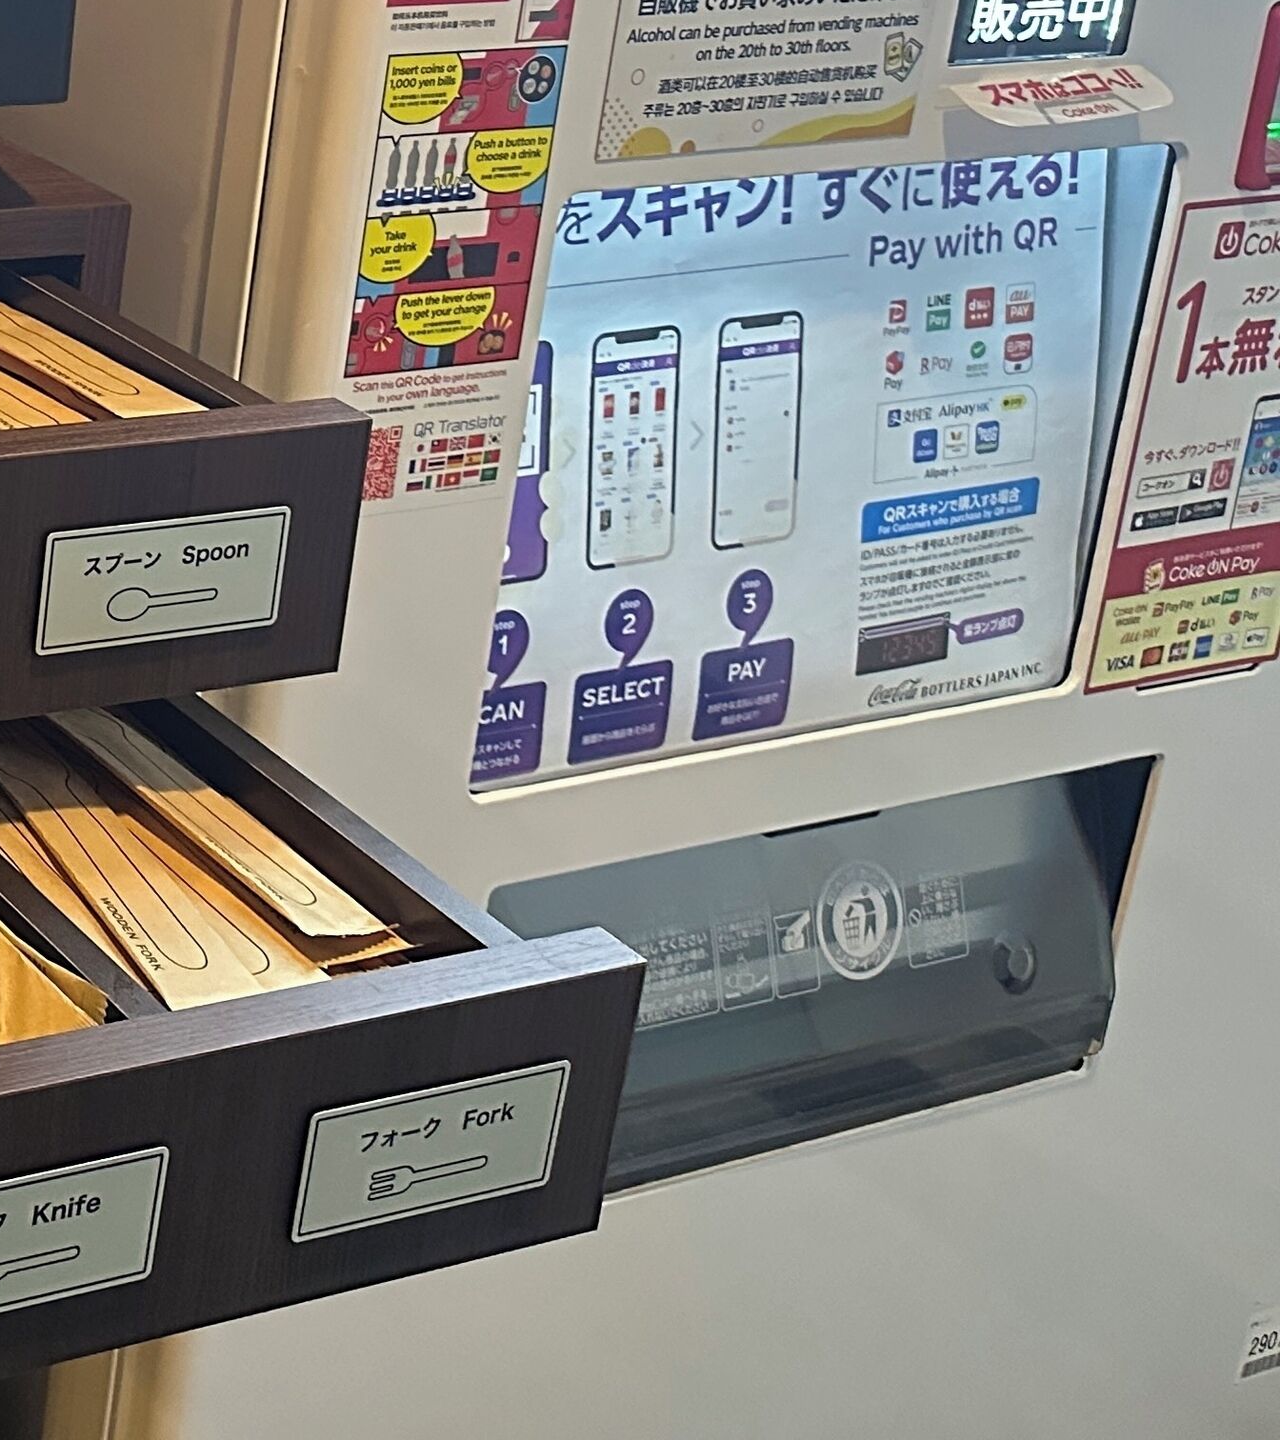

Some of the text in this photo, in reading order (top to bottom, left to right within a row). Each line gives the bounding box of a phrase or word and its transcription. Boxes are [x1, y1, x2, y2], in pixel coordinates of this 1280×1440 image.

[627, 13, 919, 44] Alcohol can be purchased from vending machines
[696, 37, 851, 62] on the 20th to 30th floors.
[392, 64, 457, 76] Insert coins or
[390, 75, 456, 89] 1,000 yen bills
[385, 231, 406, 241] Take
[869, 217, 1058, 270] Pay with QR
[370, 241, 417, 256] your drink
[401, 292, 491, 308] Push the lever down
[927, 294, 951, 307] LINE
[1010, 304, 1029, 318] PAY
[402, 304, 486, 321] to get your change
[928, 314, 949, 328] Pay
[414, 415, 507, 437] QR Translator
[83, 539, 250, 577] スプーン Spoon
[1169, 564, 1205, 582] Coke
[1231, 555, 1260, 575] Pay
[743, 592, 756, 614] 3
[1202, 594, 1220, 607] LINE
[622, 614, 637, 635] 2
[498, 635, 508, 655] 1
[728, 658, 766, 682] PAY
[1106, 655, 1135, 672] VISA
[582, 676, 665, 708] SELECT
[921, 676, 982, 697] BOTTLERS
[985, 669, 1019, 687] JAPAN
[479, 699, 525, 725] CAN
[100, 897, 165, 972] WOODEN FORK
[360, 1102, 515, 1153] フォーク Fork
[31, 1193, 101, 1227] Knife
